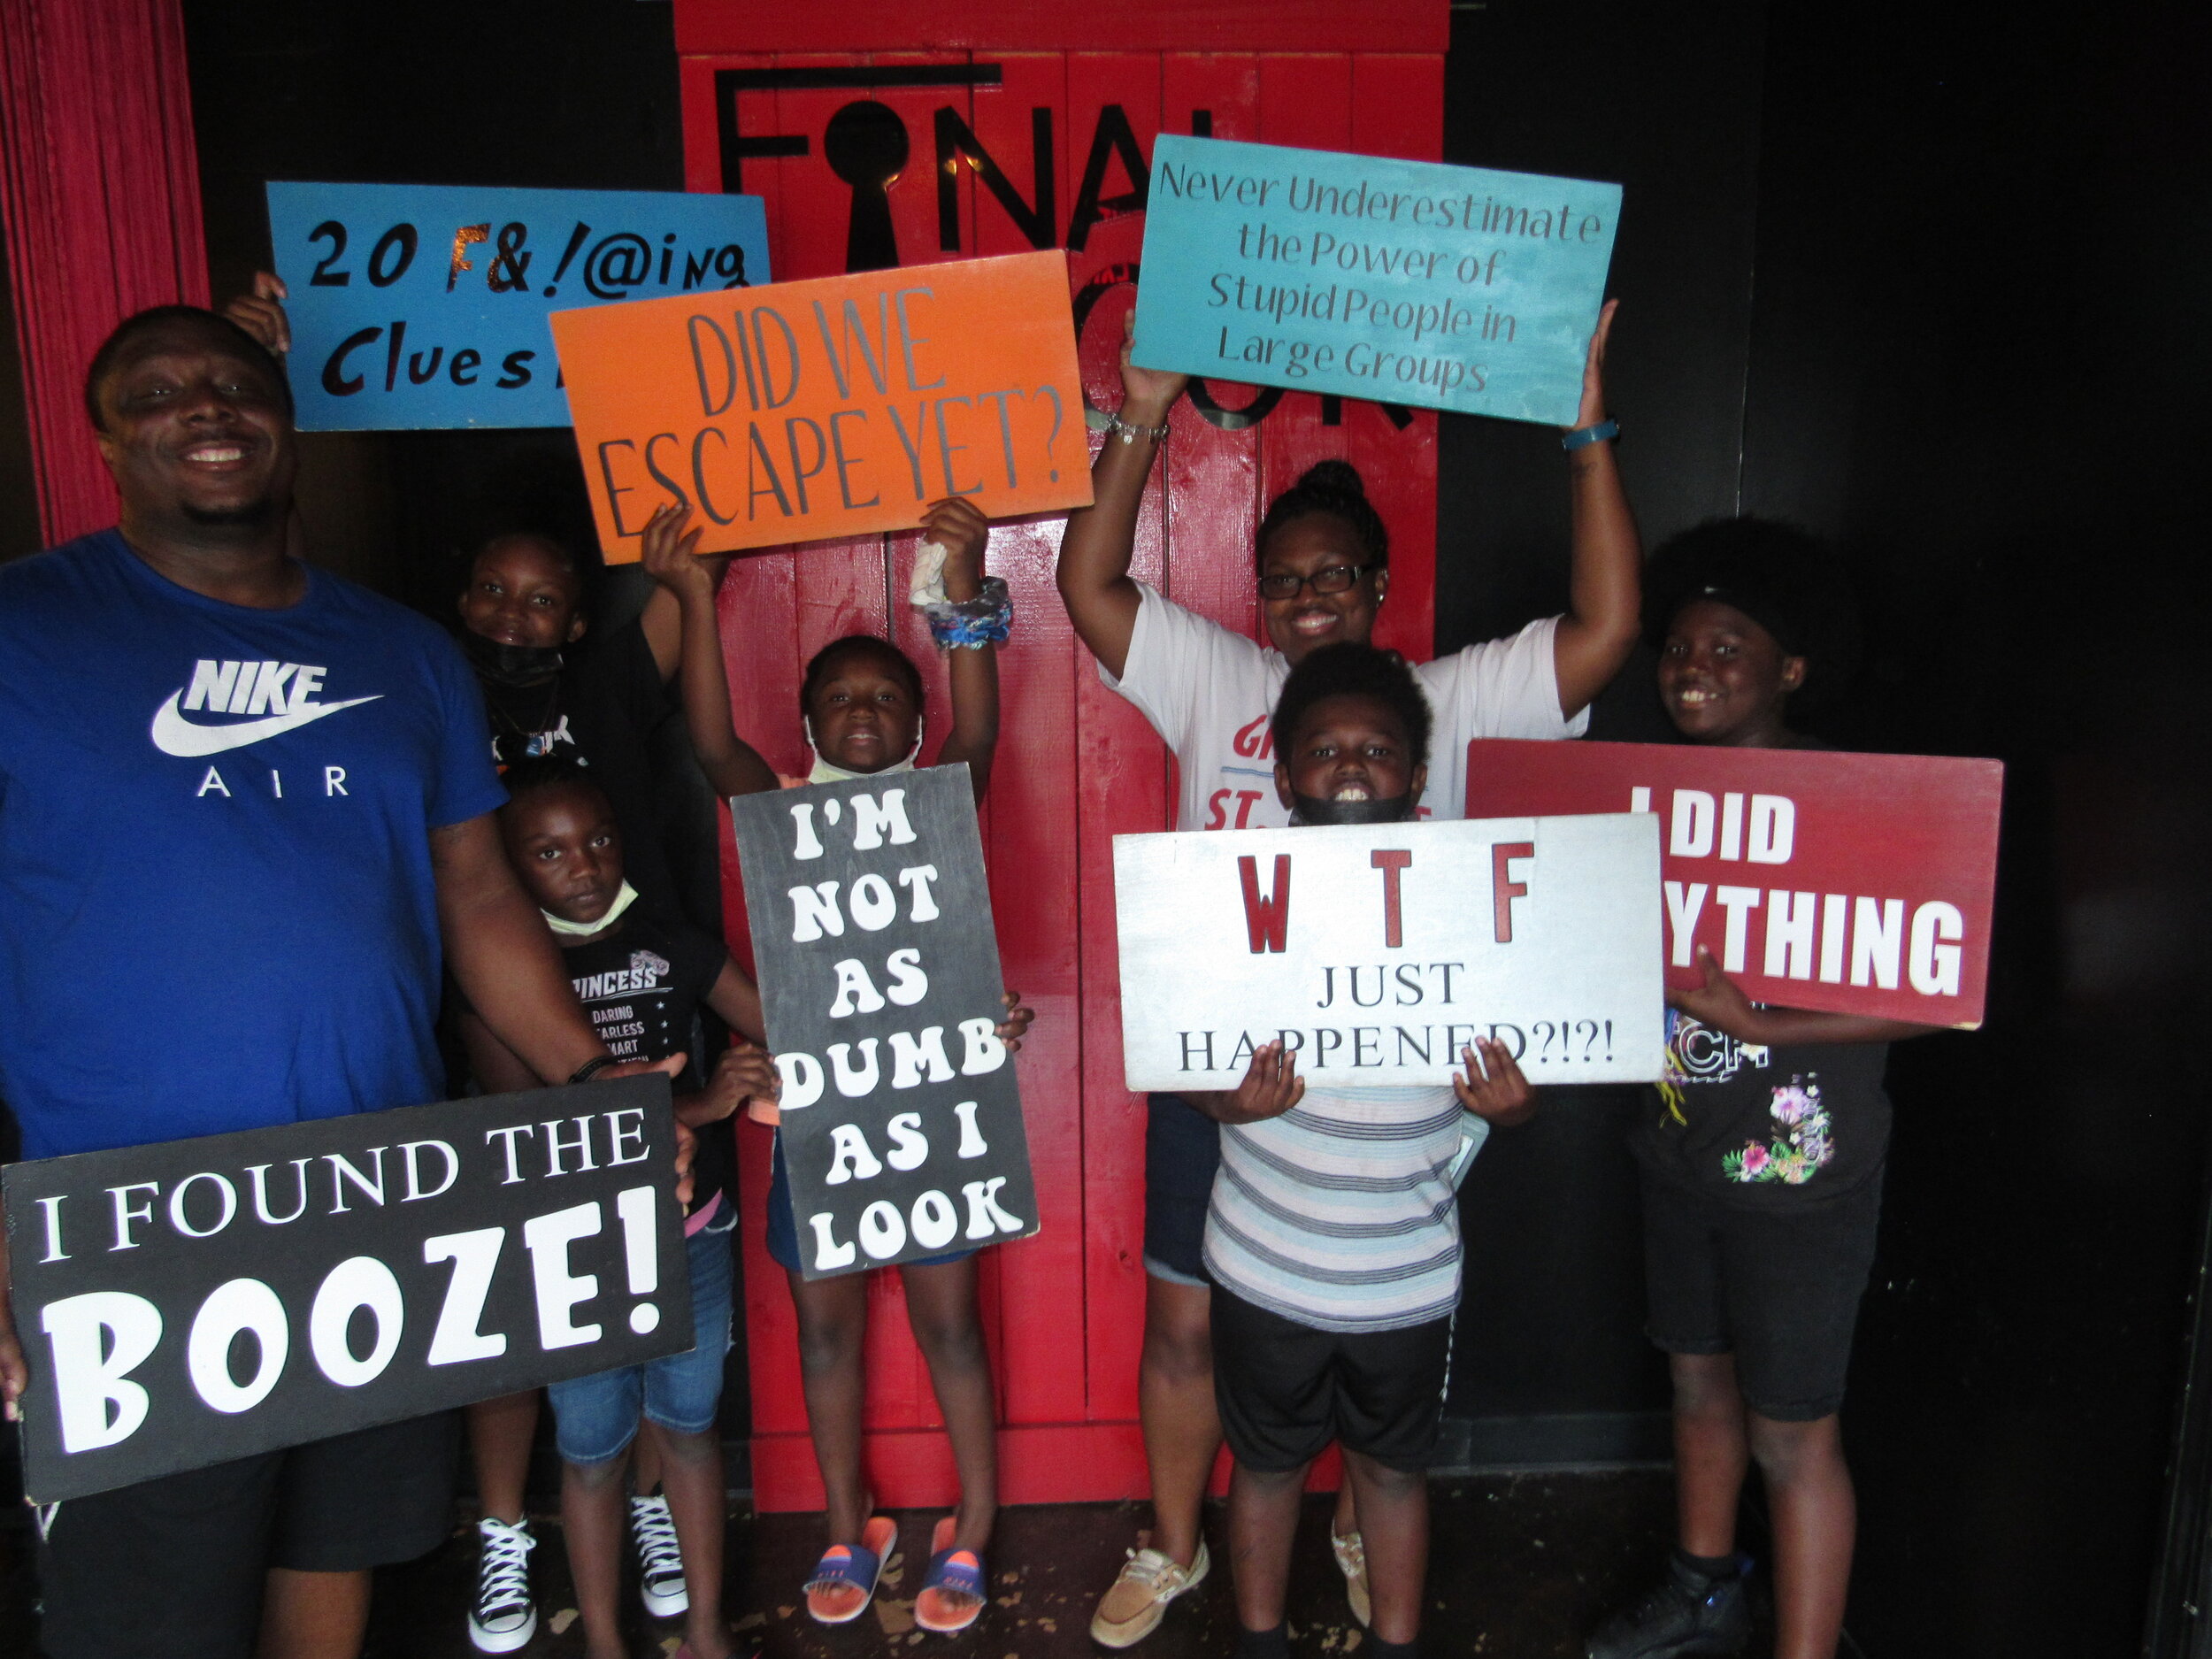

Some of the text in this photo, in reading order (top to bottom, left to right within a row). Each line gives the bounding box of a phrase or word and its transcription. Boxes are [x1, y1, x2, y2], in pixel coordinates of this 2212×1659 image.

[1160, 161, 1601, 244] Never Underestimate
[308, 220, 419, 288] 20
[1239, 223, 1507, 286] the Power of
[1207, 273, 1517, 342] Stupid People in
[320, 321, 536, 396] Clues
[687, 306, 799, 417] DID
[811, 287, 946, 400] WE
[1217, 326, 1487, 396] Large Groups
[598, 385, 1063, 538] ESCAPE YET?
[183, 659, 328, 716] NIKE
[790, 788, 918, 860] I'M
[1669, 788, 1796, 864] DID
[787, 864, 940, 943] NOT
[1663, 879, 1964, 997] YTHING
[572, 967, 658, 1000] INCESS
[592, 1005, 634, 1024] DARING
[829, 948, 929, 1018] AS
[1317, 962, 1465, 1008] JUST
[596, 1021, 645, 1041] ARLESS
[607, 1039, 638, 1056] MART
[774, 1017, 1007, 1110] DUMB
[826, 1101, 987, 1185] AS I
[35, 1108, 650, 1263] I FOUND THE
[810, 1177, 1024, 1271] LOOK
[42, 1185, 660, 1455] BOOZE!
